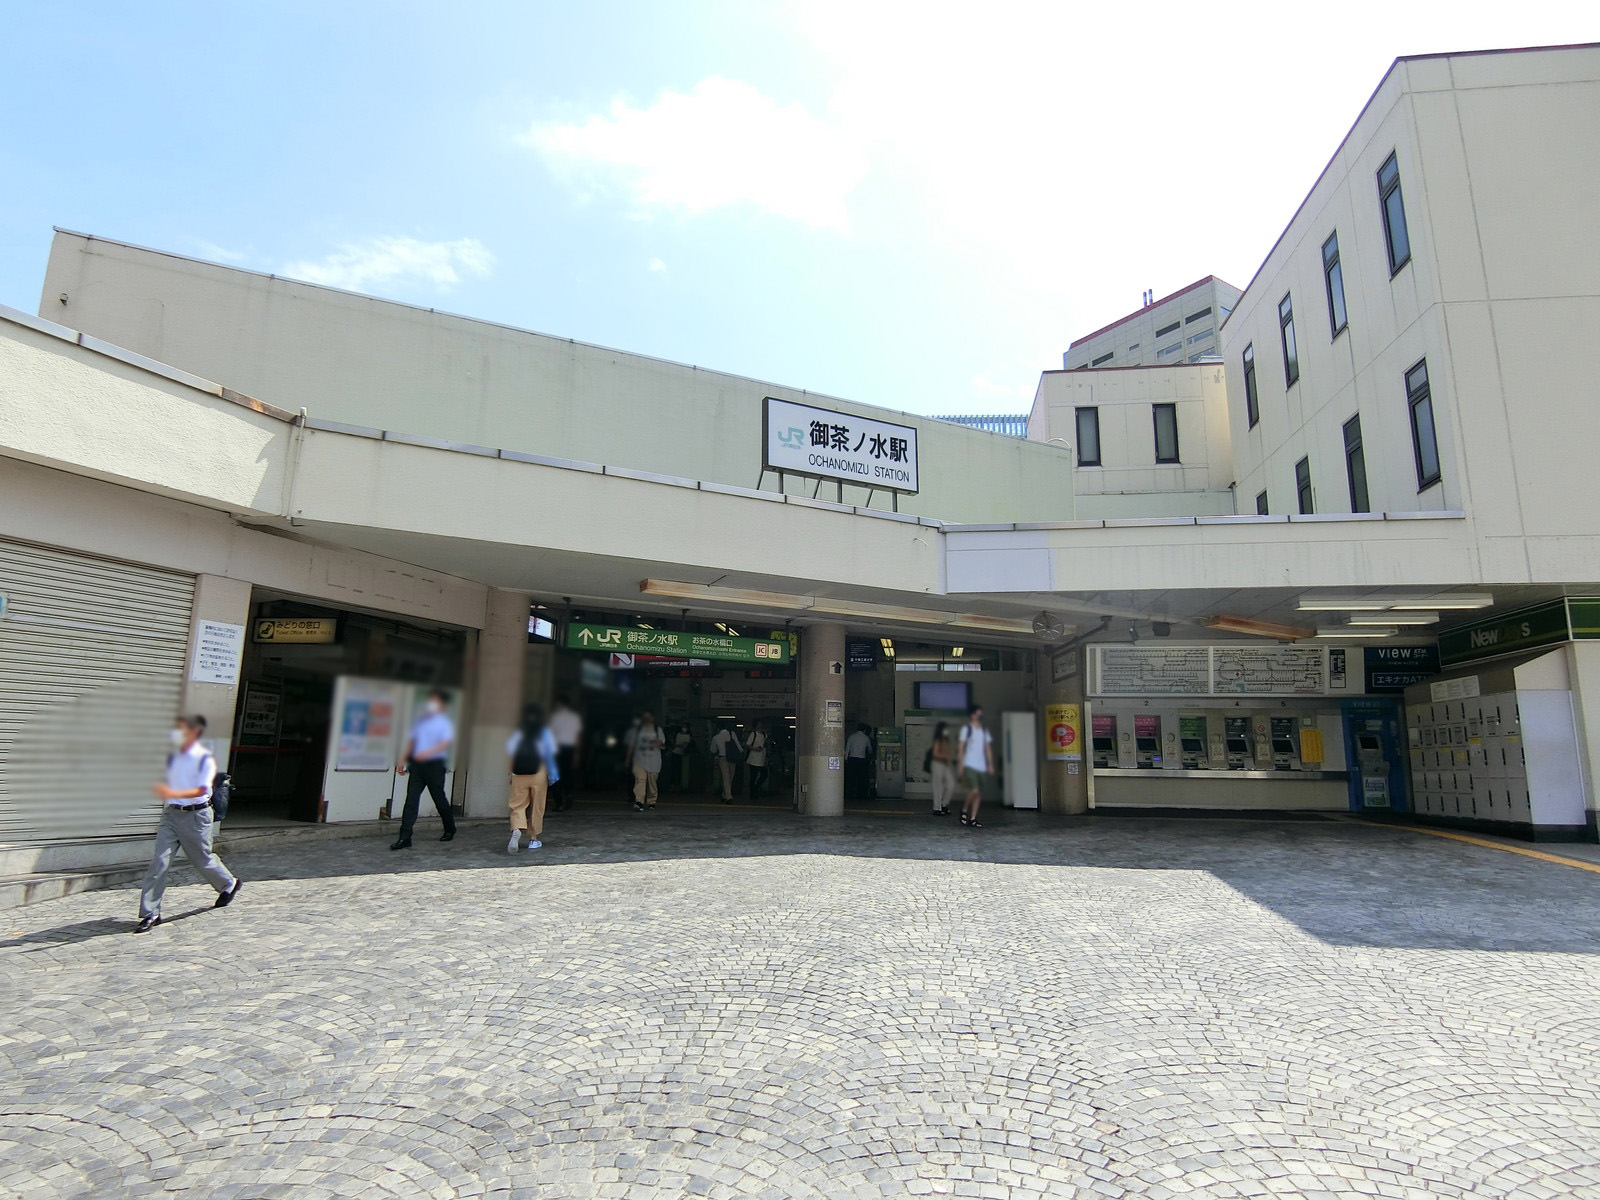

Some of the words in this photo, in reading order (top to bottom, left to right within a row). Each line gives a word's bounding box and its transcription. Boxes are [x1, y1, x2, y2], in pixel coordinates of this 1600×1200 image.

[777, 427, 805, 445] JR
[809, 420, 909, 464] 御茶ノ水駅
[808, 453, 870, 475] OCHANOMIZU
[874, 465, 910, 483] STATION
[276, 621, 321, 630] みどりの窓口
[596, 629, 622, 643] JR
[626, 630, 678, 646] 御茶ノ水駅
[692, 637, 733, 647] お茶の水橋口
[626, 643, 665, 652] Ochanomizu
[665, 646, 688, 655] Station
